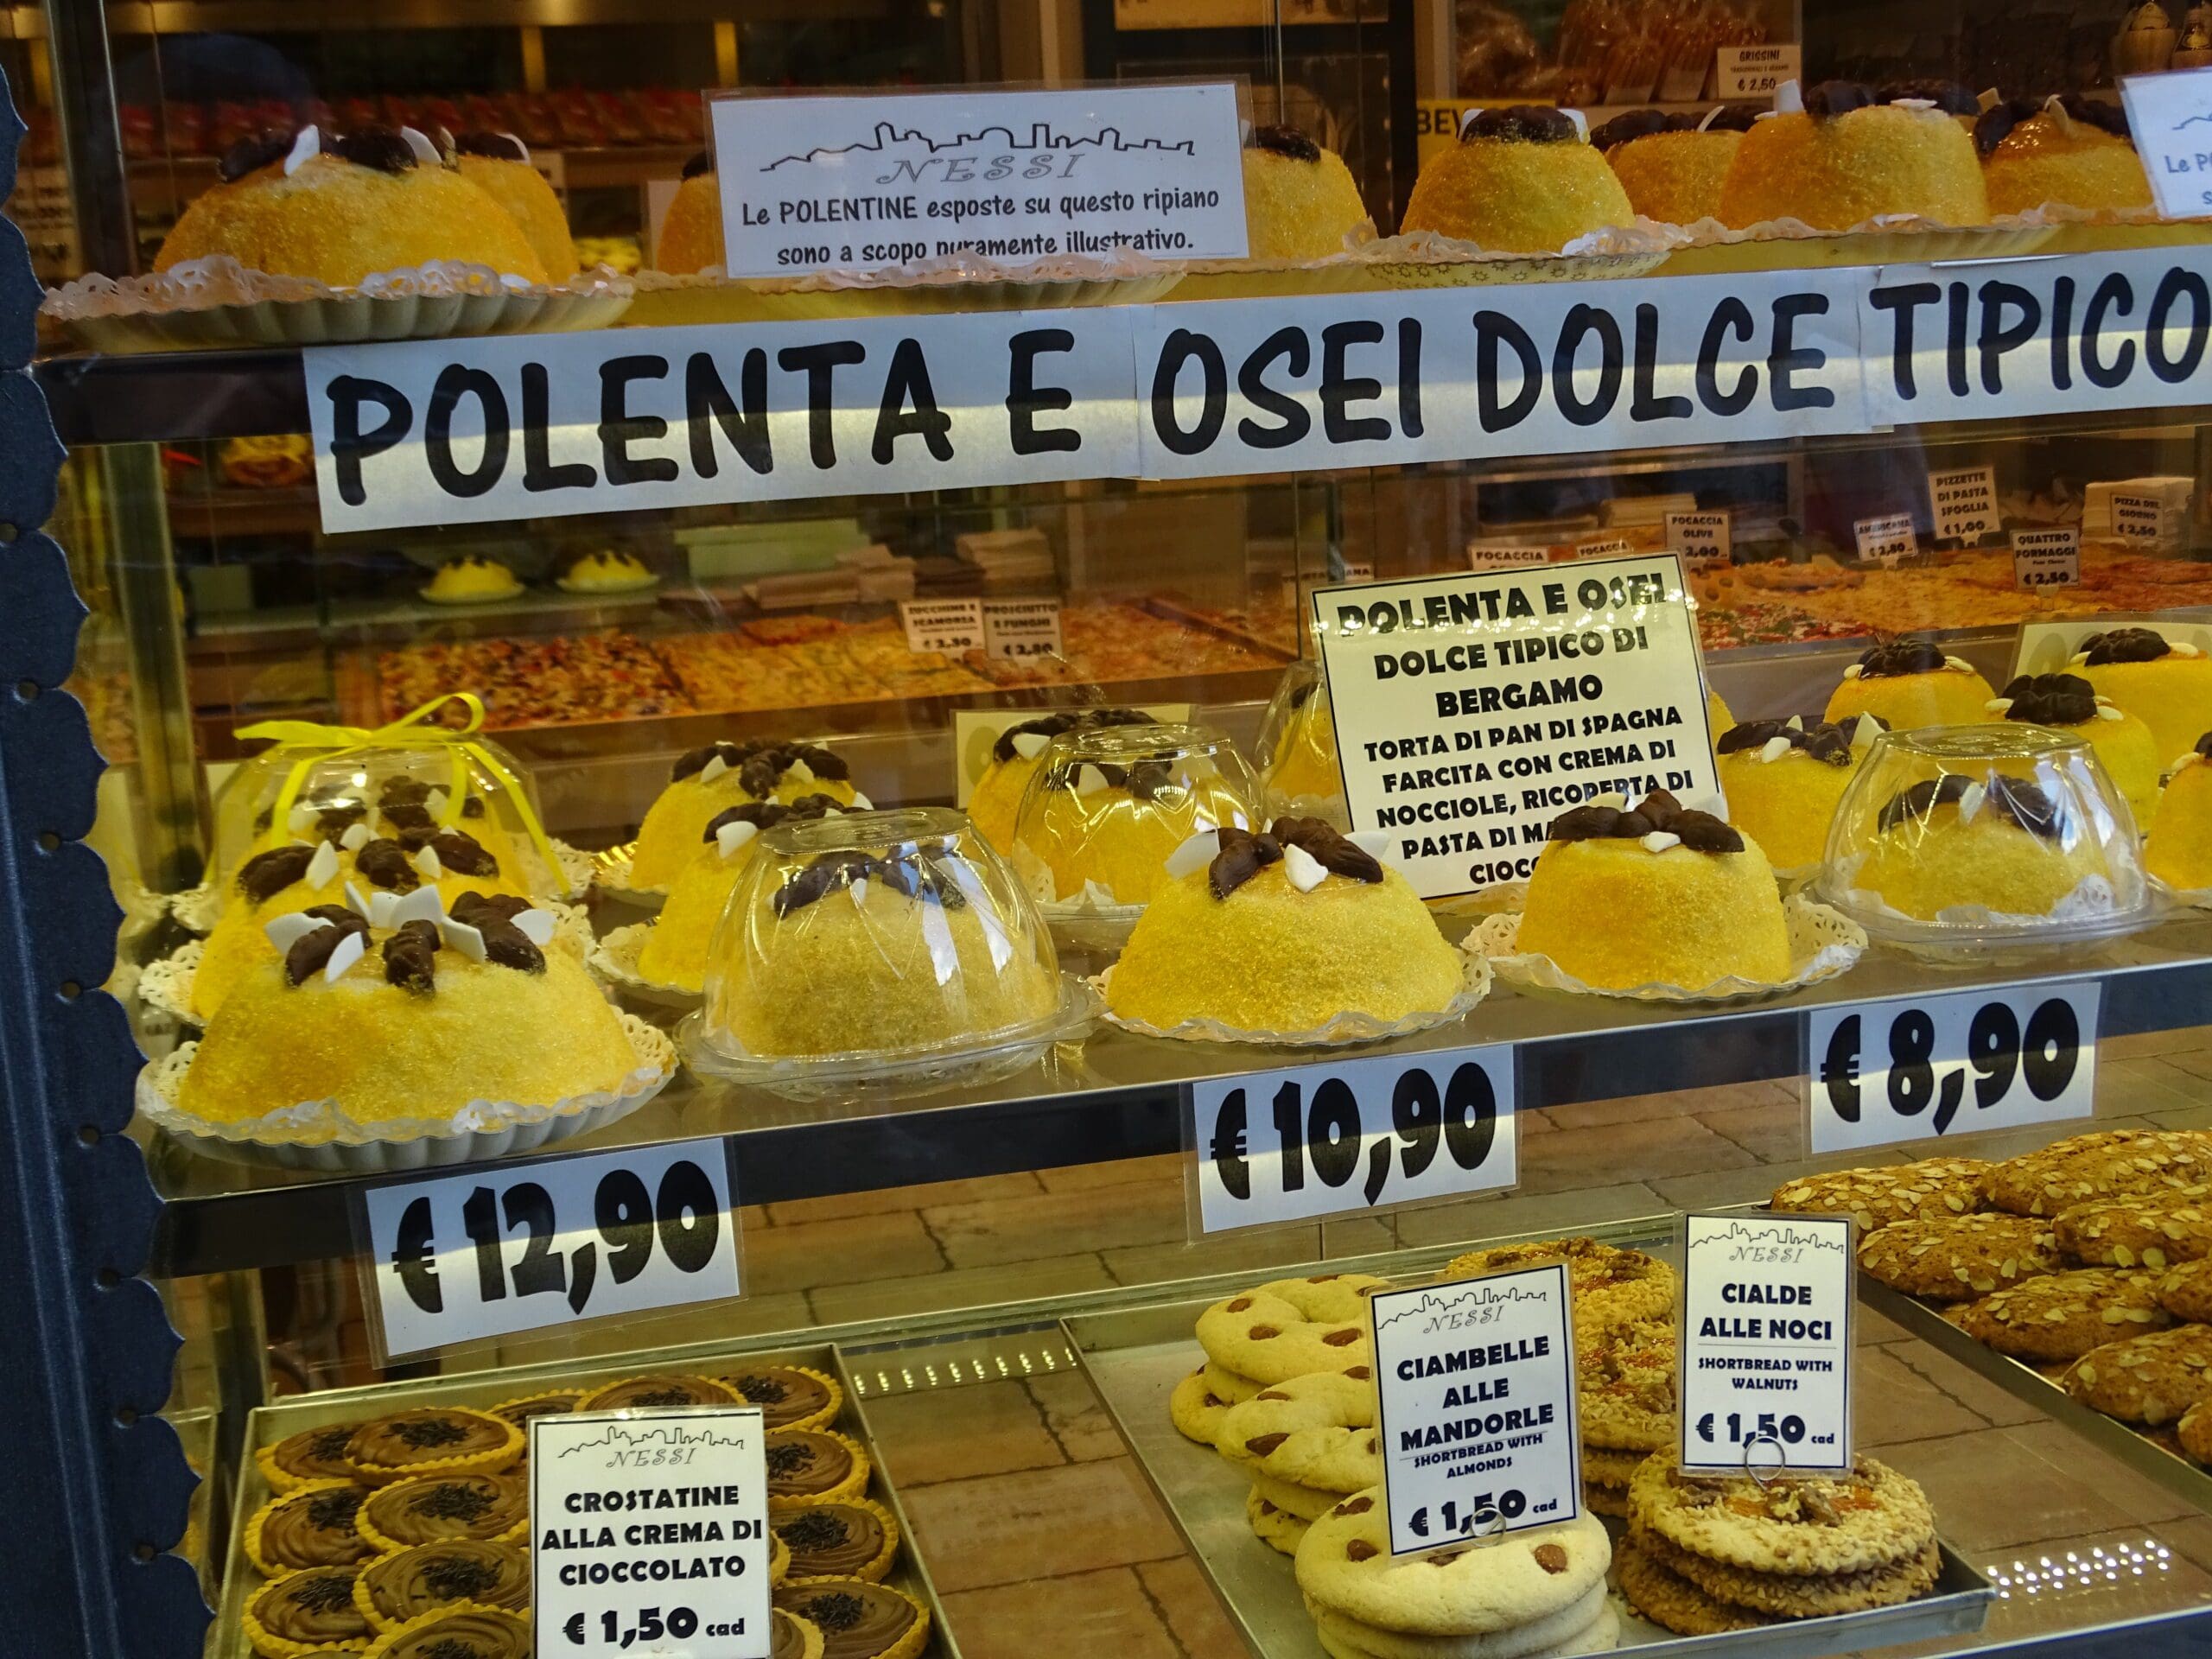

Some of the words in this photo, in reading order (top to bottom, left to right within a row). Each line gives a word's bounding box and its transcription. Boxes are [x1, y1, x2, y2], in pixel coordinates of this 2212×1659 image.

[1739, 49, 1780, 62] GRISSINI
[875, 154, 1086, 184] NESSI
[2164, 156, 2190, 173] Le
[743, 203, 770, 226] Le
[779, 196, 918, 223] POLENTINE
[926, 195, 1015, 223] esposte
[1025, 196, 1051, 215] su
[1059, 191, 1135, 221] questo
[1143, 185, 1219, 217] ripiano
[778, 246, 830, 265] sono
[841, 246, 852, 263] a
[862, 241, 926, 268] scopo
[1066, 228, 1193, 252] illustrativo.
[326, 338, 954, 505] POLENTA
[1006, 328, 1082, 456] E
[1150, 316, 1425, 456] OSEI
[1473, 292, 1835, 434] DOLCE
[1868, 265, 2209, 402] TIPICO
[1936, 472, 1986, 486] PIZZETTE
[1937, 492, 1950, 502] DI
[1953, 486, 1988, 500] PASTA
[1672, 517, 1723, 525] FOCACCIA
[1942, 502, 1989, 517] SFOGLIA
[2018, 533, 2070, 545] QUATTRO
[1476, 550, 1543, 561] FOCACCIA
[1337, 587, 1535, 638] POLENTA
[1542, 583, 1568, 614] E
[1578, 573, 1666, 611] OSEI
[1374, 644, 1488, 681] DOLCE
[1494, 631, 1605, 665] TIPICO
[1613, 626, 1649, 652] DI
[1435, 674, 1604, 718] BERGAMO
[1364, 736, 1448, 762] TORTA
[1454, 730, 1483, 752] DI
[1489, 722, 1543, 747] PAN
[1548, 719, 1575, 741] DI
[1582, 706, 1682, 736] SPAGNA
[1382, 760, 1493, 793] FARCITA
[1497, 754, 1552, 779] CON
[1559, 743, 1644, 771] CREMA
[1649, 739, 1676, 760] DI
[1376, 792, 1517, 828] NOCCIOLE,
[1522, 774, 1661, 810] RICOPERTA
[1666, 770, 1694, 791] DI
[1402, 830, 1484, 860] PASTA
[1490, 826, 1516, 849] DI
[1821, 1014, 1861, 1123] €
[1887, 997, 2080, 1136] 8,90
[1210, 1088, 1250, 1200] €
[1273, 1061, 1497, 1207] 10,90
[391, 1196, 443, 1313] €
[462, 1160, 719, 1315] 12,90
[1729, 1246, 1805, 1264] NESSI
[1721, 1283, 1813, 1306] CIALDE
[1422, 1305, 1504, 1334] NESSI
[1699, 1317, 1762, 1338] ALLE
[1769, 1319, 1832, 1341] NOCI
[1397, 1335, 1550, 1382] CIAMBELLE
[1698, 1357, 1792, 1372] SHORTBREAD
[1795, 1360, 1833, 1372] WITH
[1442, 1377, 1510, 1409] ALLE
[1732, 1377, 1798, 1391] WALNUTS
[1401, 1403, 1554, 1452] MANDORLE
[1695, 1413, 1714, 1443] €
[1726, 1413, 1806, 1450] 1,50
[1811, 1433, 1834, 1445] cad
[605, 1447, 697, 1468] NESSI
[1414, 1441, 1503, 1468] SHORTBREAD
[1508, 1433, 1543, 1449] WITH
[1446, 1457, 1513, 1479] ALMONDS
[564, 1485, 740, 1513] CROSTATINE
[1408, 1507, 1429, 1537] €
[1440, 1489, 1527, 1535] 1,50
[1533, 1499, 1558, 1514] cad
[541, 1527, 616, 1550] ALLA
[624, 1521, 724, 1546] CREMA
[732, 1519, 762, 1541] DI
[559, 1555, 746, 1586] CIOCCOLATO
[562, 1612, 585, 1645] €
[601, 1606, 699, 1649] 1,50
[705, 1618, 745, 1637] cad
